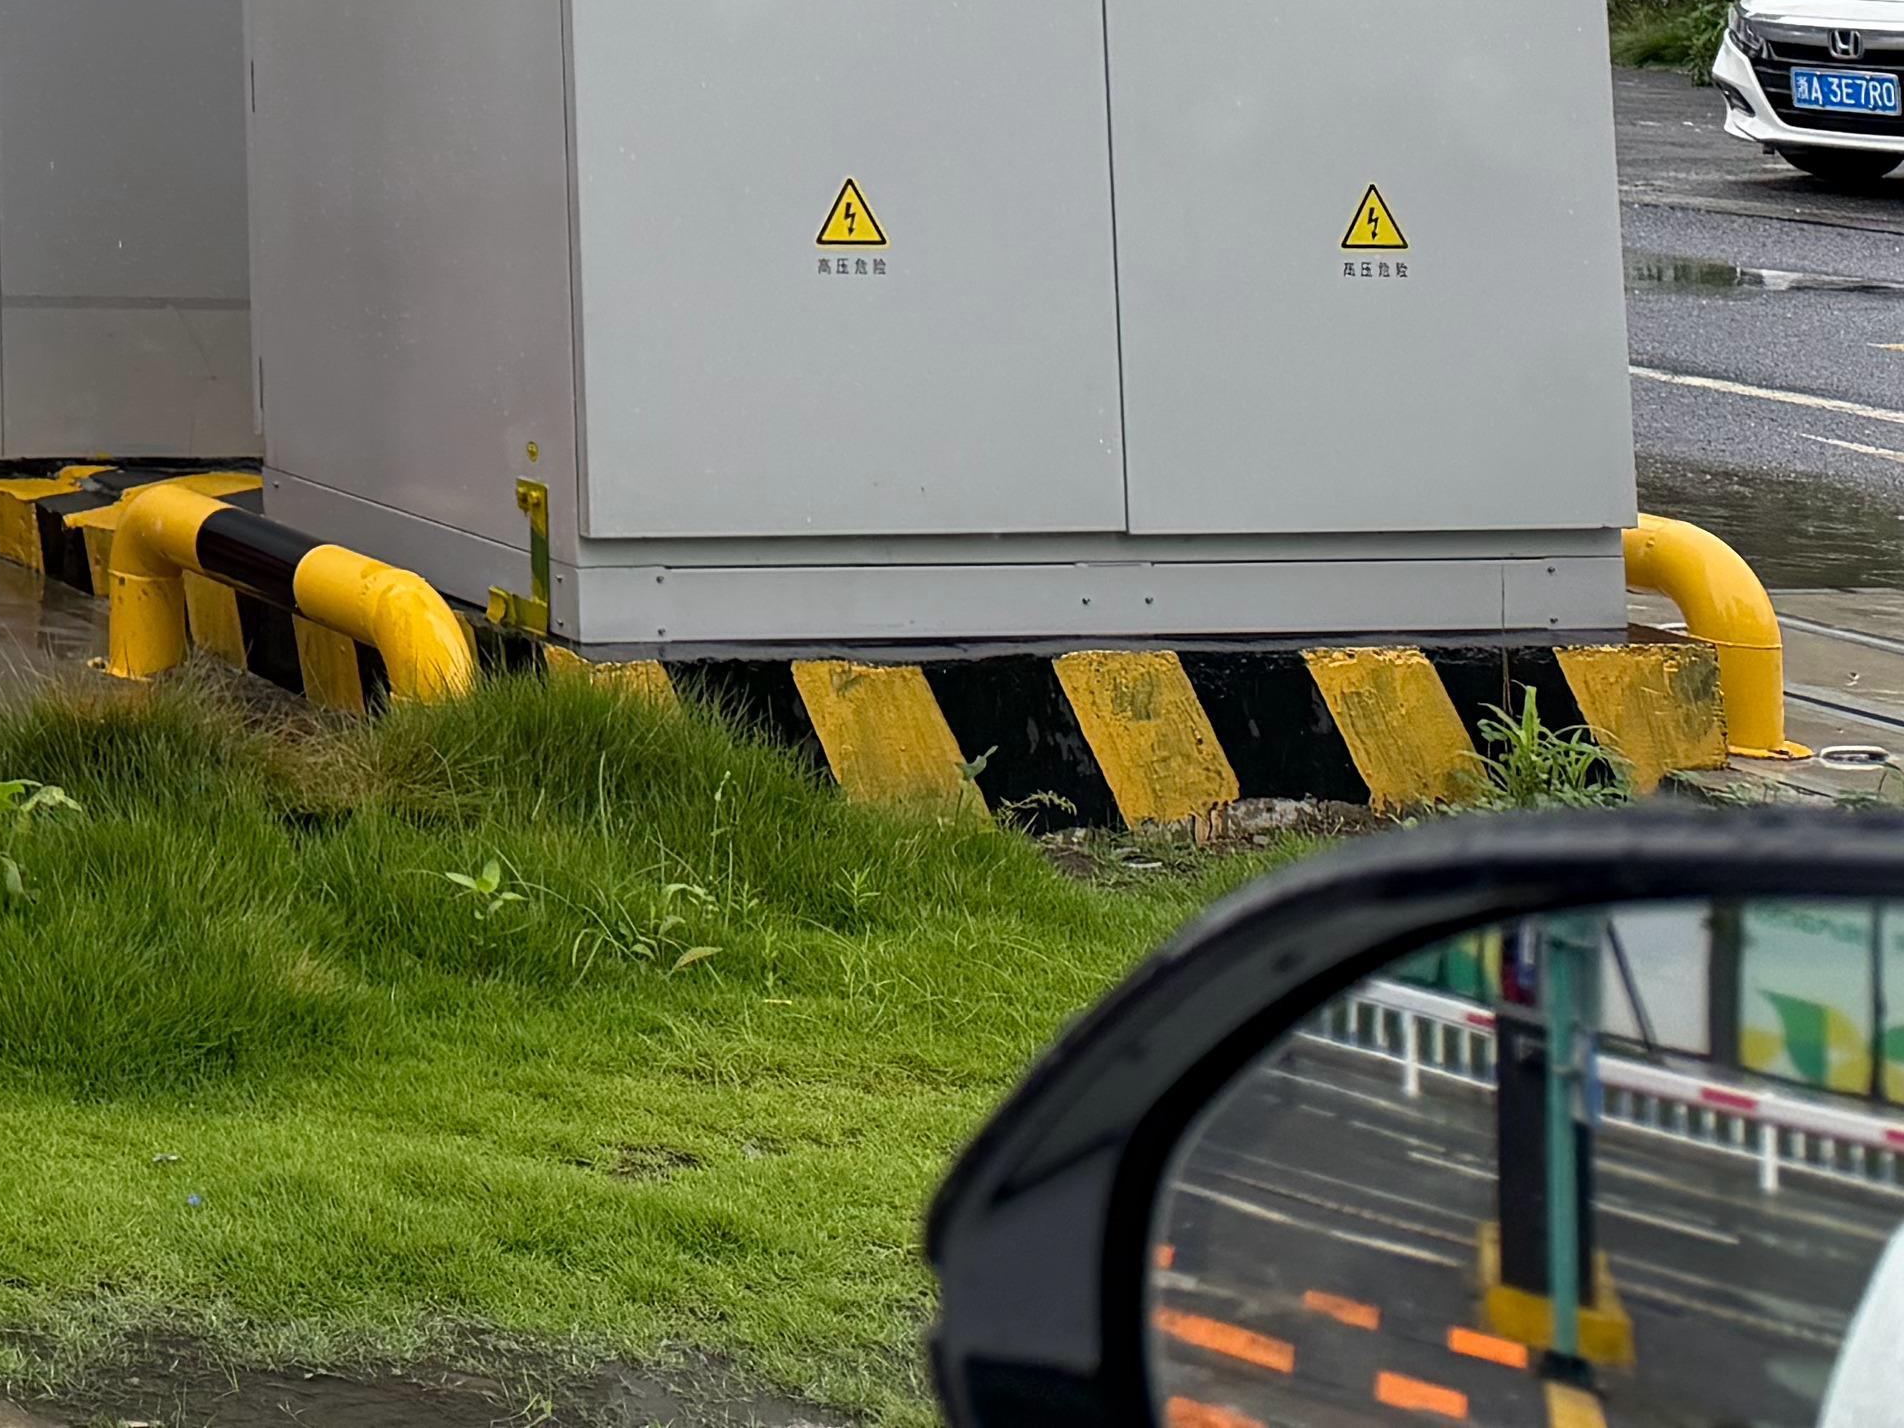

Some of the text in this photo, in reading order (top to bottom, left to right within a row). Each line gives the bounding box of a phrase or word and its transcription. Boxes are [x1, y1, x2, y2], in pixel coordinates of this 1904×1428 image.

[817, 257, 887, 275] 高压危险
[1343, 261, 1409, 278] 高压危险
